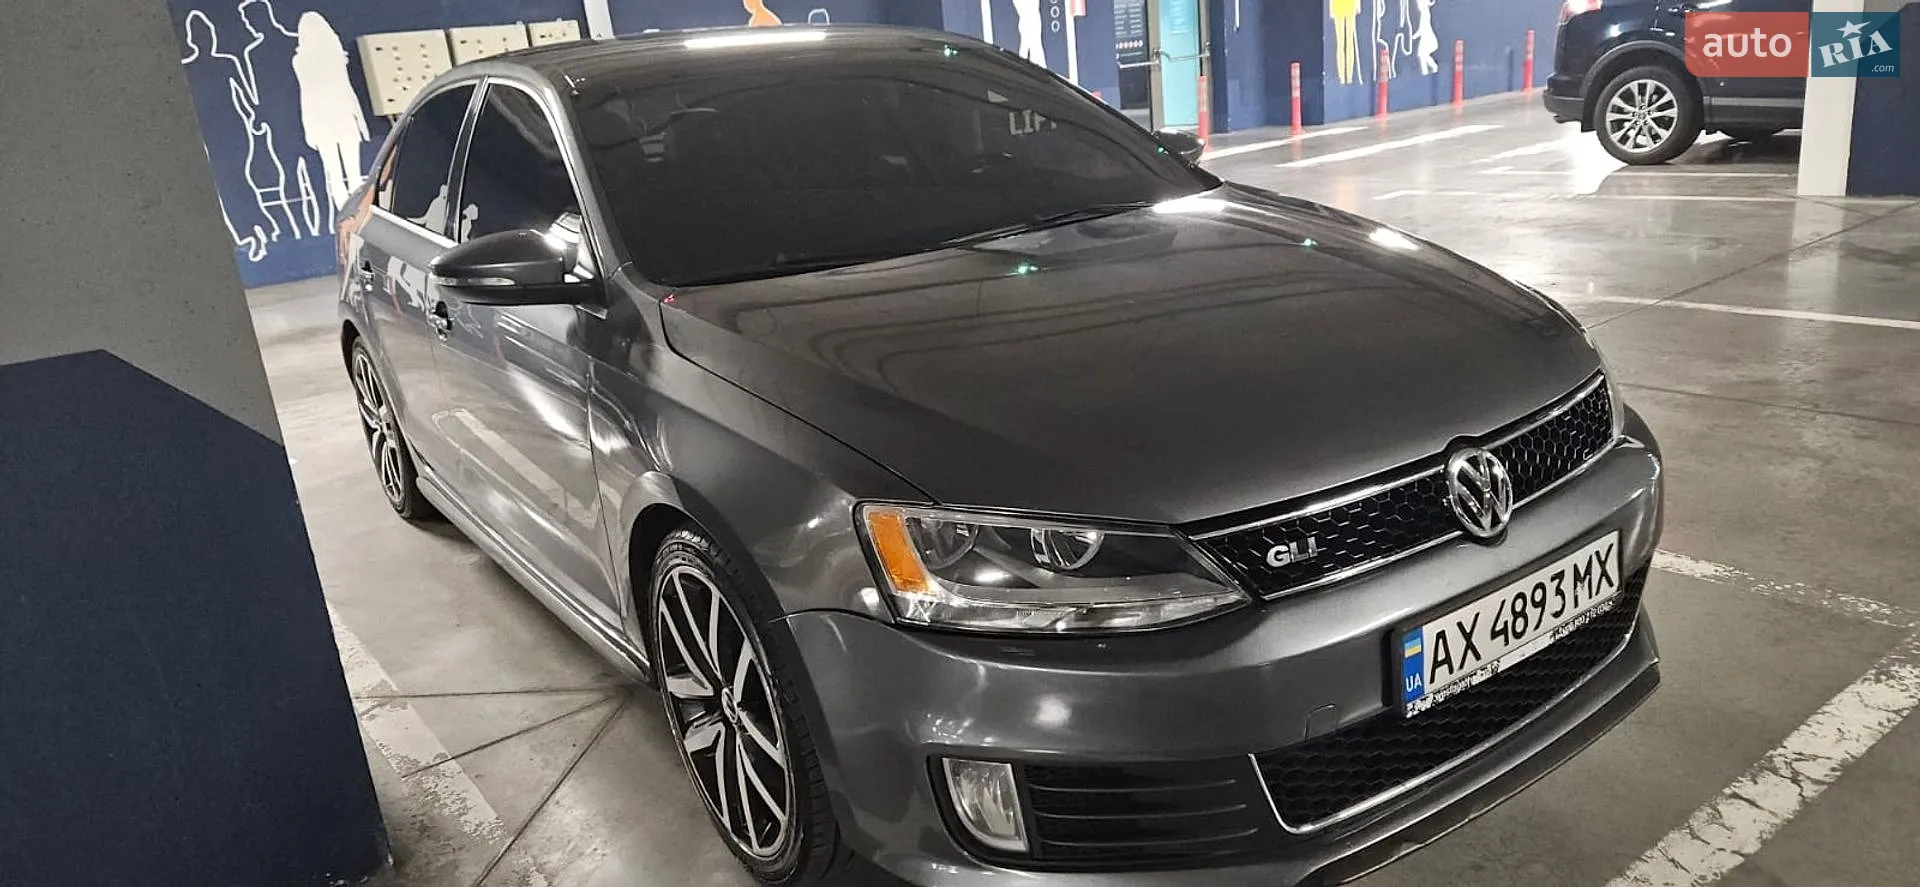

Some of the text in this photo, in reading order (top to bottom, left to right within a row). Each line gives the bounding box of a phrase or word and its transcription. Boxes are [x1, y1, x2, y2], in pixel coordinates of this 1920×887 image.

[1266, 536, 1319, 568] GLI
[1429, 611, 1482, 684] AX
[1490, 568, 1567, 647] 4893
[1573, 542, 1615, 609] MX
[1405, 677, 1423, 693] UA
